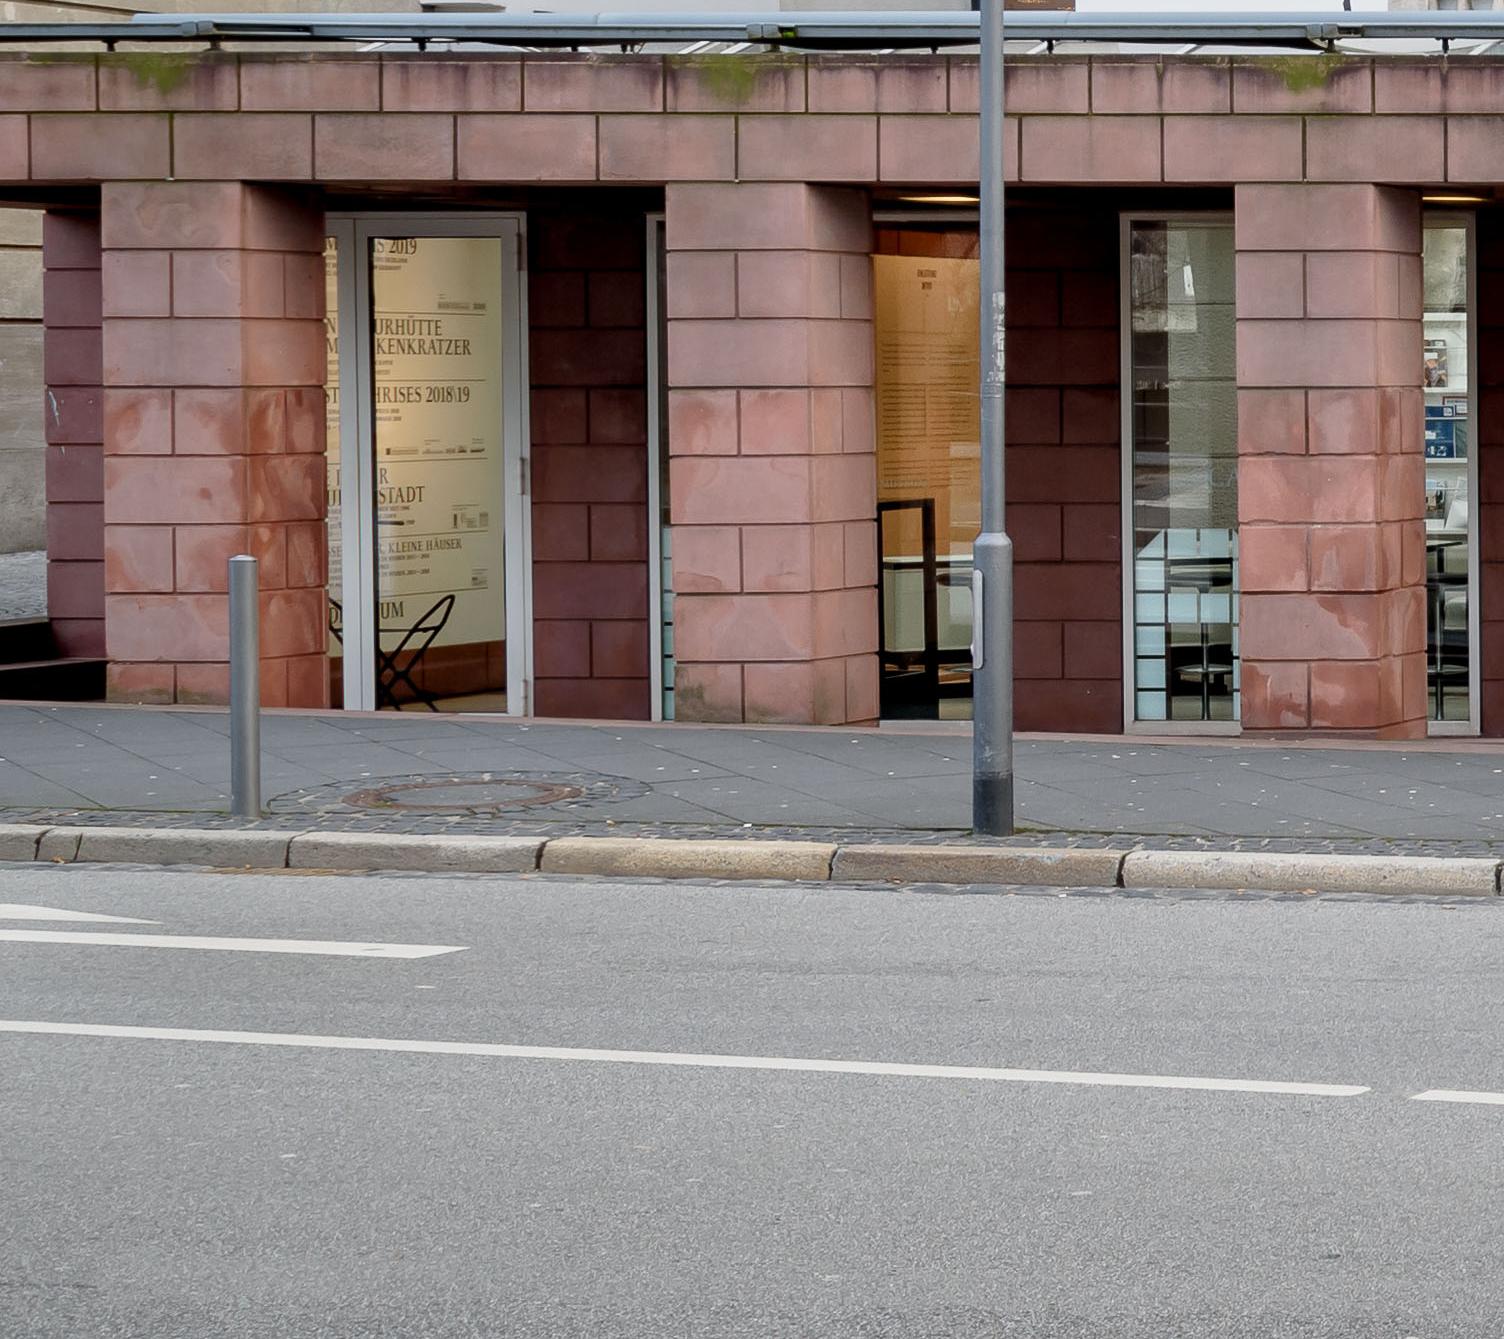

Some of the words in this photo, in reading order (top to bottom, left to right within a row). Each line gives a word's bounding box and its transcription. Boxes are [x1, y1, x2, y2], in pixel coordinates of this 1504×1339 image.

[389, 238, 417, 255] 2019
[377, 338, 472, 356] KENKRATZER
[376, 386, 422, 404] HRISES
[379, 486, 425, 505] STADT
[388, 540, 422, 554] KLEINE
